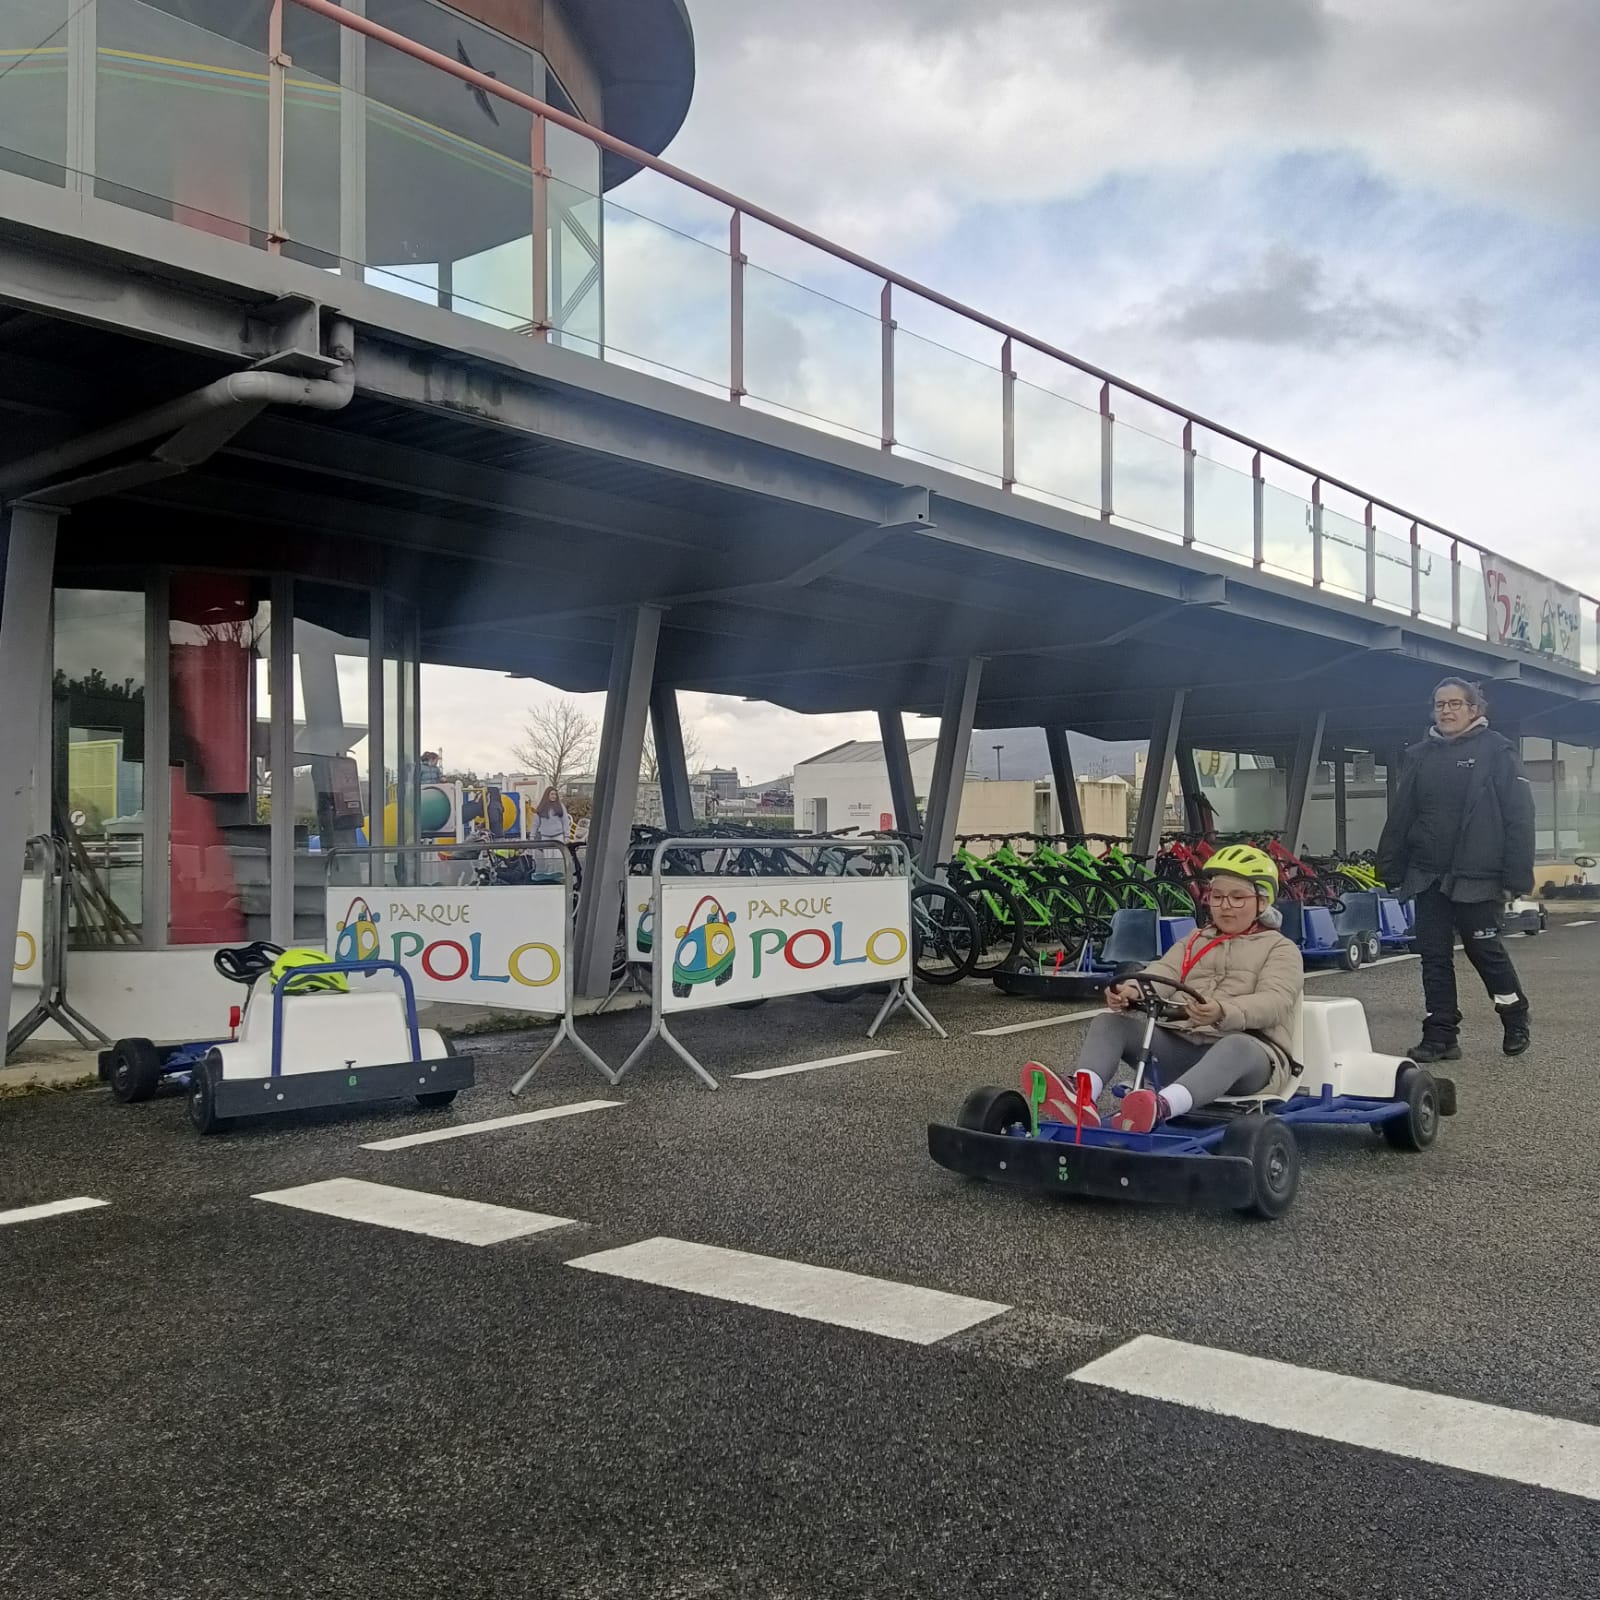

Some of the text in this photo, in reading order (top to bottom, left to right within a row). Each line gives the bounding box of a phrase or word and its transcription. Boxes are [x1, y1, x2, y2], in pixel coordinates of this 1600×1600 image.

[389, 903, 472, 926] PARQUE
[748, 897, 832, 920] PARQUE
[390, 931, 561, 987] POLO
[749, 921, 908, 979] POLO
